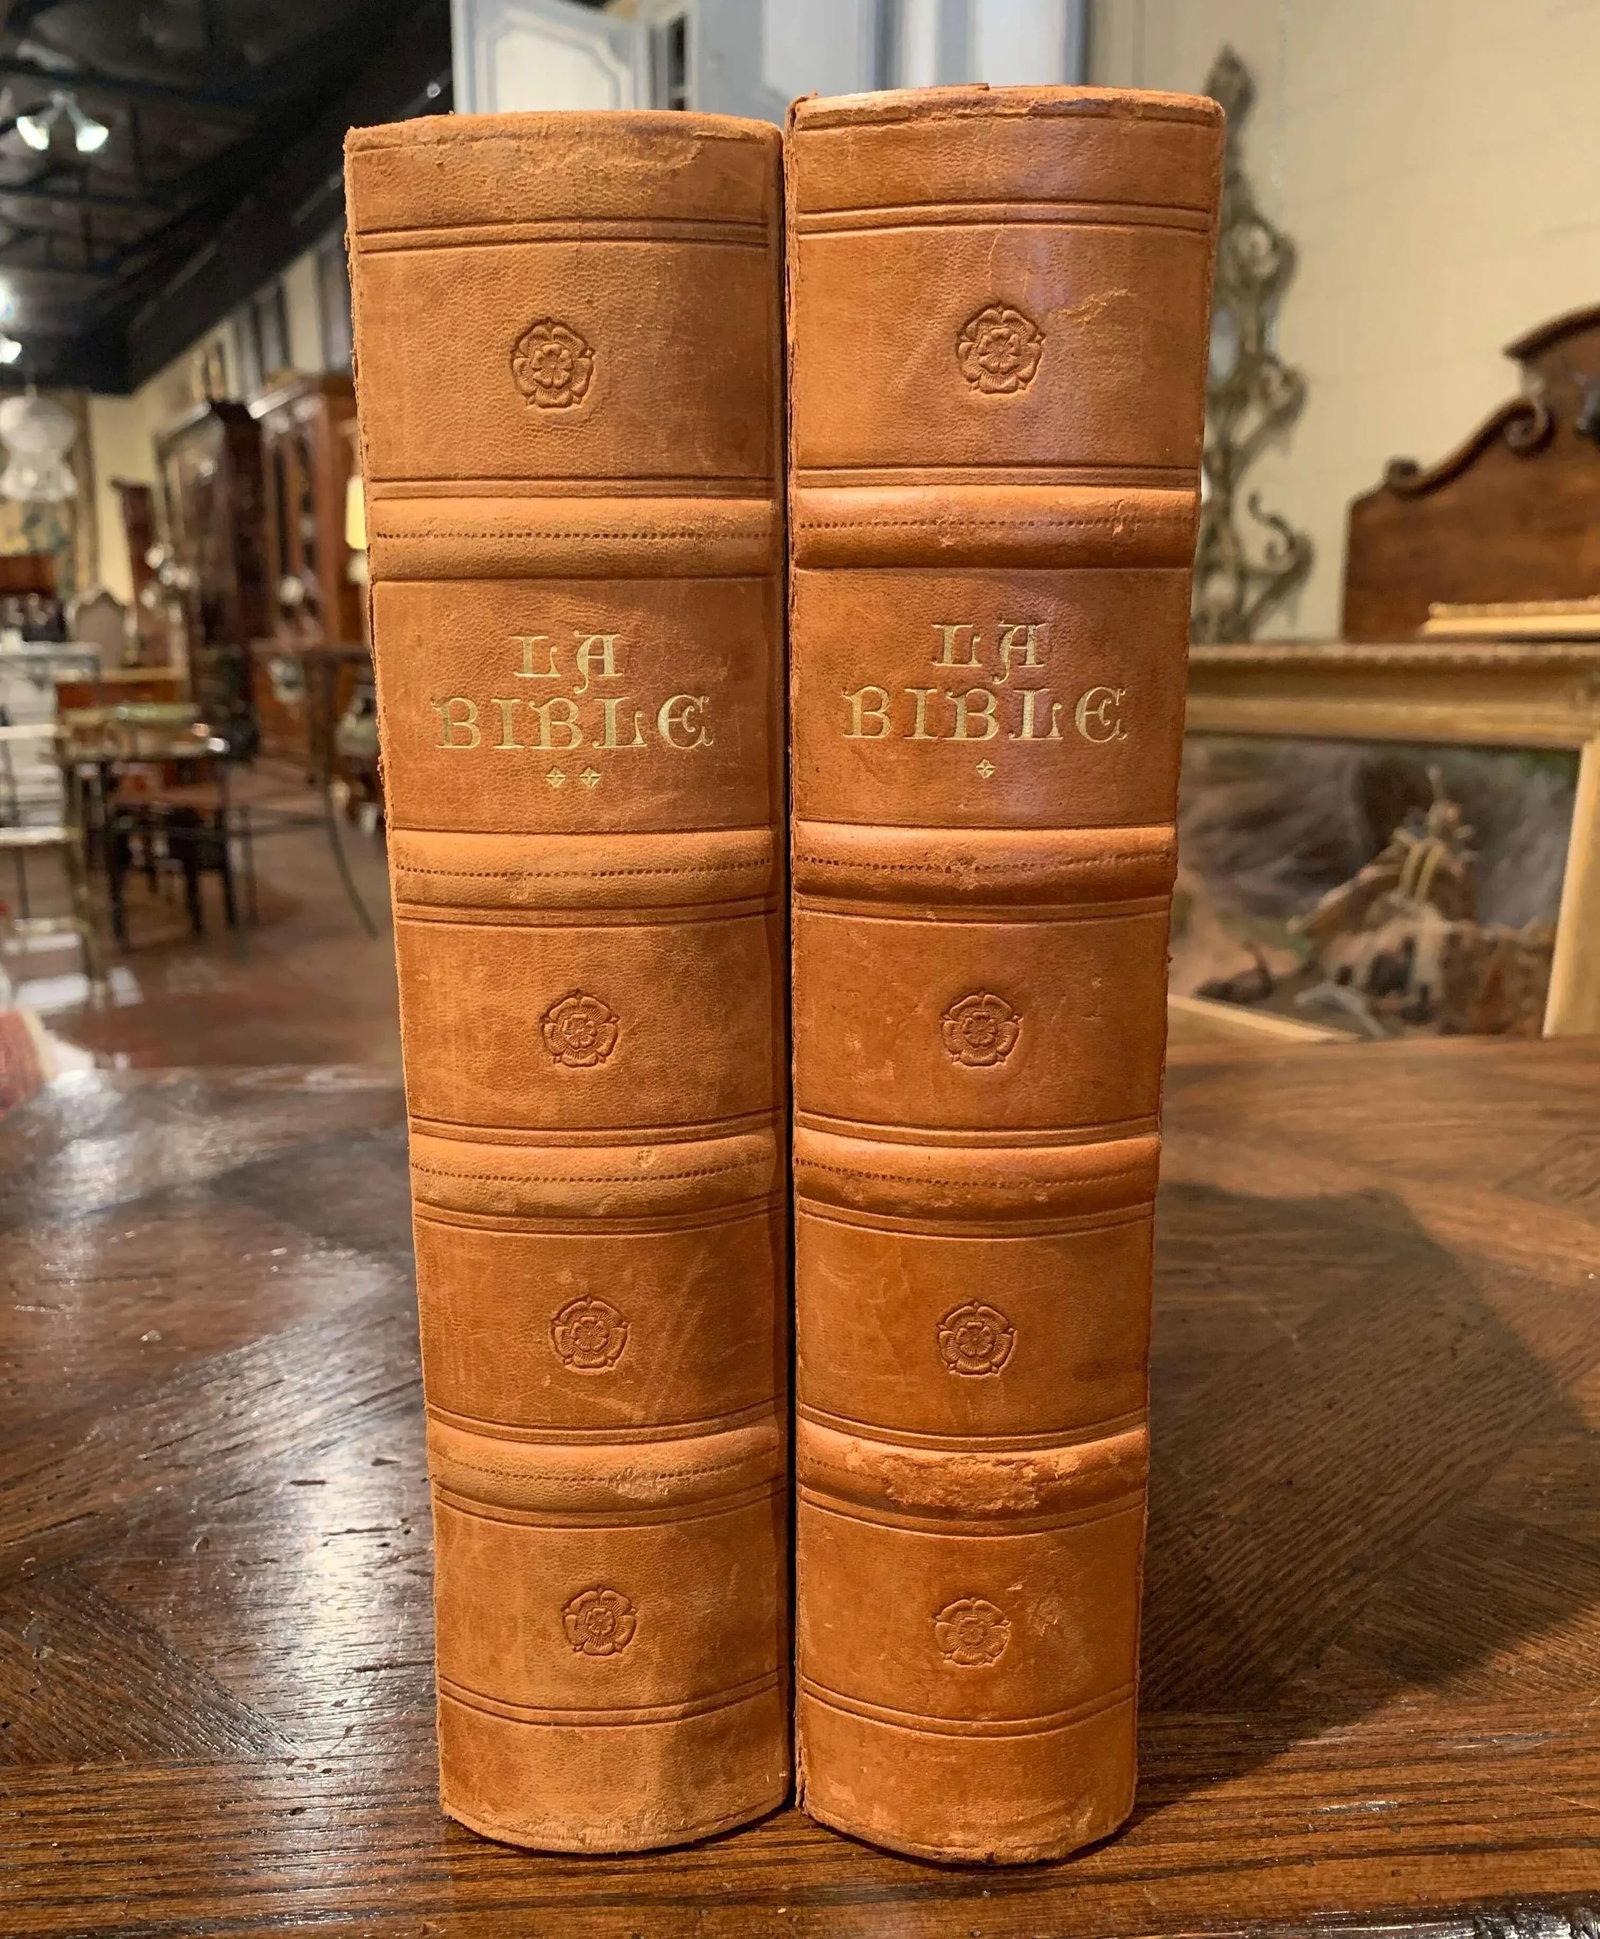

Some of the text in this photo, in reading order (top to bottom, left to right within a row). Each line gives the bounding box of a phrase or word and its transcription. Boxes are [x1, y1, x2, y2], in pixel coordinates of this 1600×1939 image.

[511, 630, 623, 694] LA
[931, 620, 1047, 685] LA
[431, 694, 714, 749] BIBLE
[841, 686, 1128, 743] BIBLE
